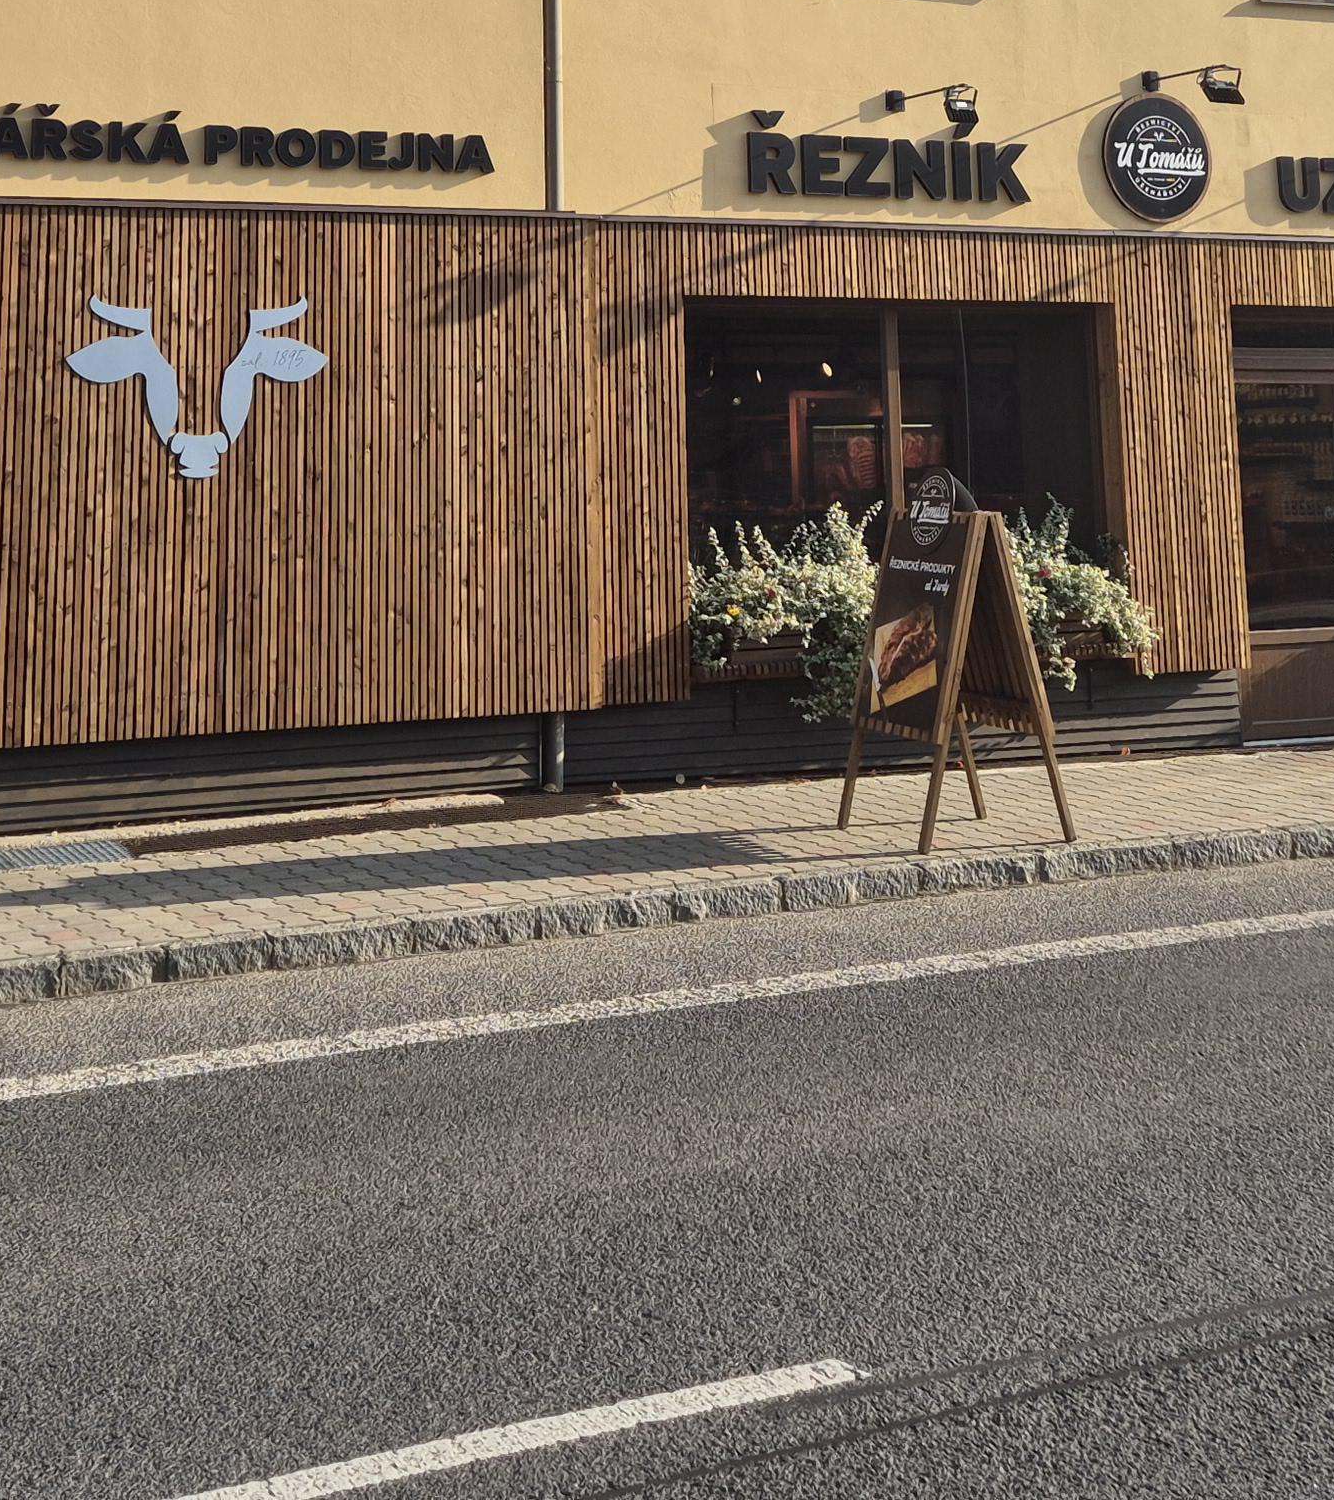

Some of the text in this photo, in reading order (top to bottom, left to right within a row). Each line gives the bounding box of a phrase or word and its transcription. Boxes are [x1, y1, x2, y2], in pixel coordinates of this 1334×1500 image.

[204, 124, 495, 174] PRODEJNA
[746, 109, 1031, 203] ŘEZNÍK
[1114, 142, 1206, 171] U Tomášů
[910, 501, 921, 518] U
[920, 561, 956, 575] PRODUKTY
